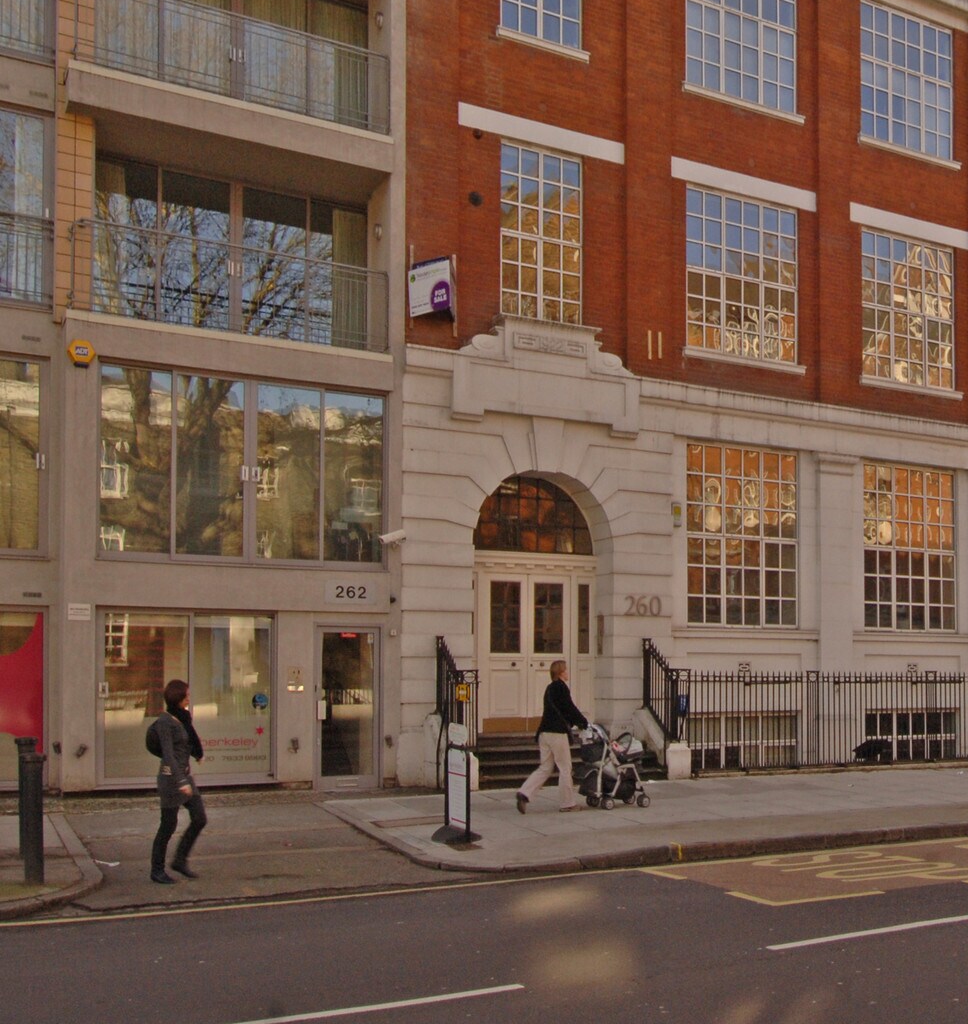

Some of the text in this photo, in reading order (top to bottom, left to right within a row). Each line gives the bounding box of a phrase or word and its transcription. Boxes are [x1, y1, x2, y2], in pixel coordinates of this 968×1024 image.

[434, 288, 446, 297] FOR
[433, 295, 448, 304] SALE
[335, 585, 367, 599] 262
[624, 595, 662, 616] 260
